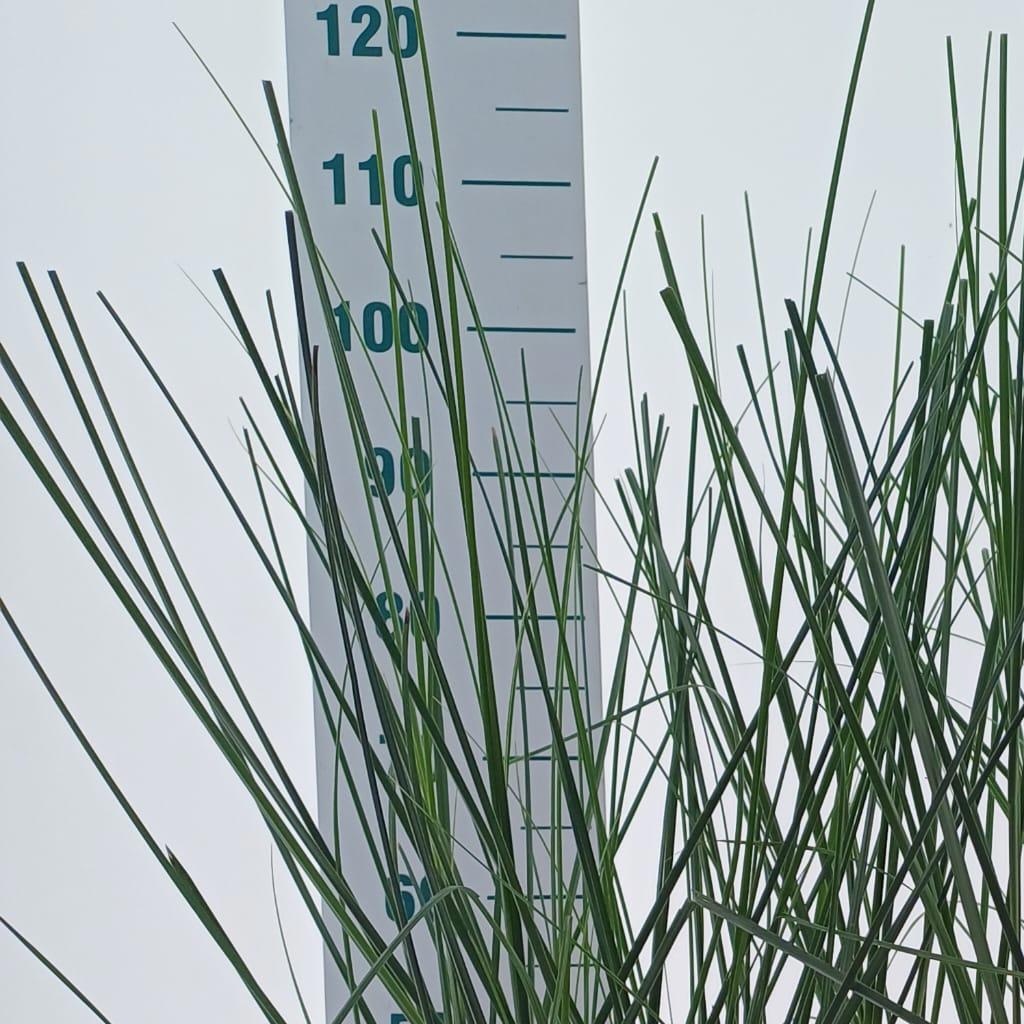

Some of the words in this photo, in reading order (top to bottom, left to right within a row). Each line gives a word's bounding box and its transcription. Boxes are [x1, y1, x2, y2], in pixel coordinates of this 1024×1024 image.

[316, 4, 419, 58] 120
[322, 153, 424, 207] 110
[333, 300, 430, 352] 100
